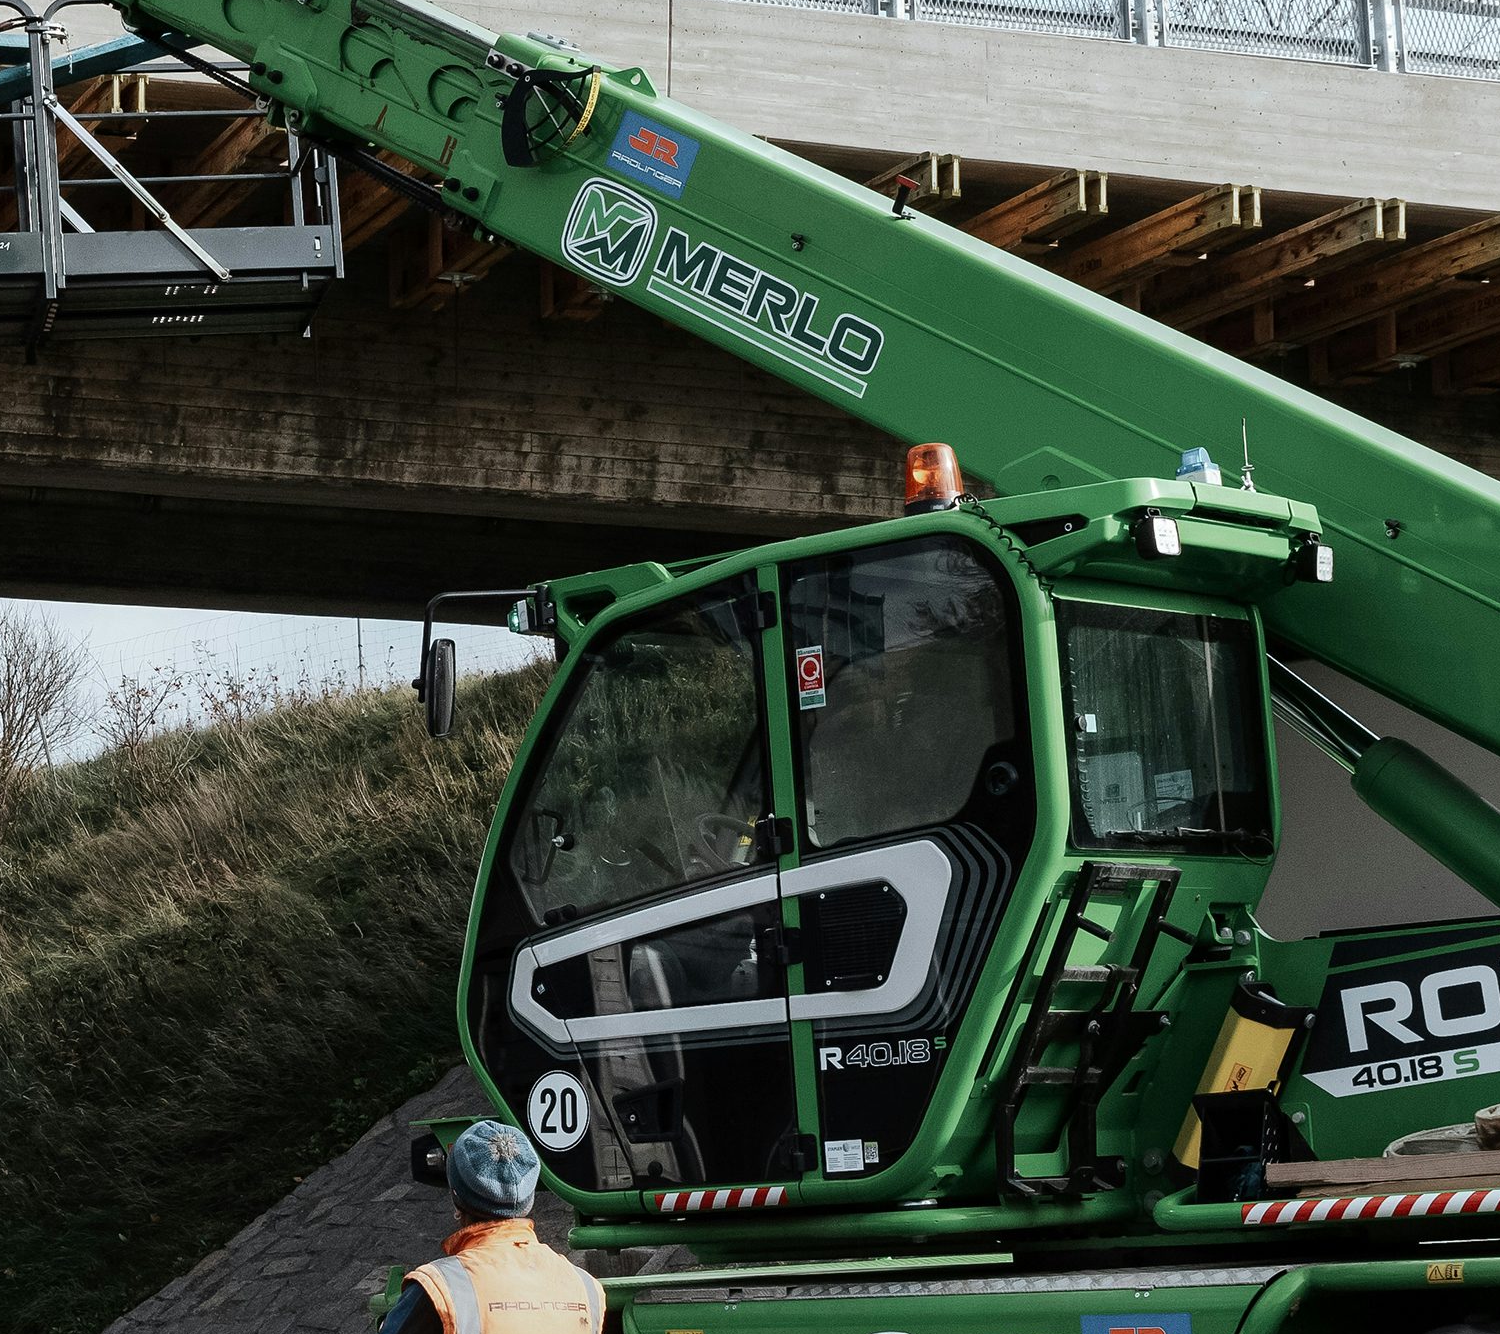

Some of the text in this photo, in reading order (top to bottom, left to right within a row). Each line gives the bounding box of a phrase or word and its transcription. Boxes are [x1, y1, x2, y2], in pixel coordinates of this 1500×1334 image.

[653, 225, 885, 376] MERLO
[819, 1047, 845, 1071] R
[846, 1038, 931, 1068] 40.18
[1351, 1049, 1481, 1089] 40.18 S
[540, 1087, 578, 1135] 20
[488, 1301, 588, 1313] RADLINGER
